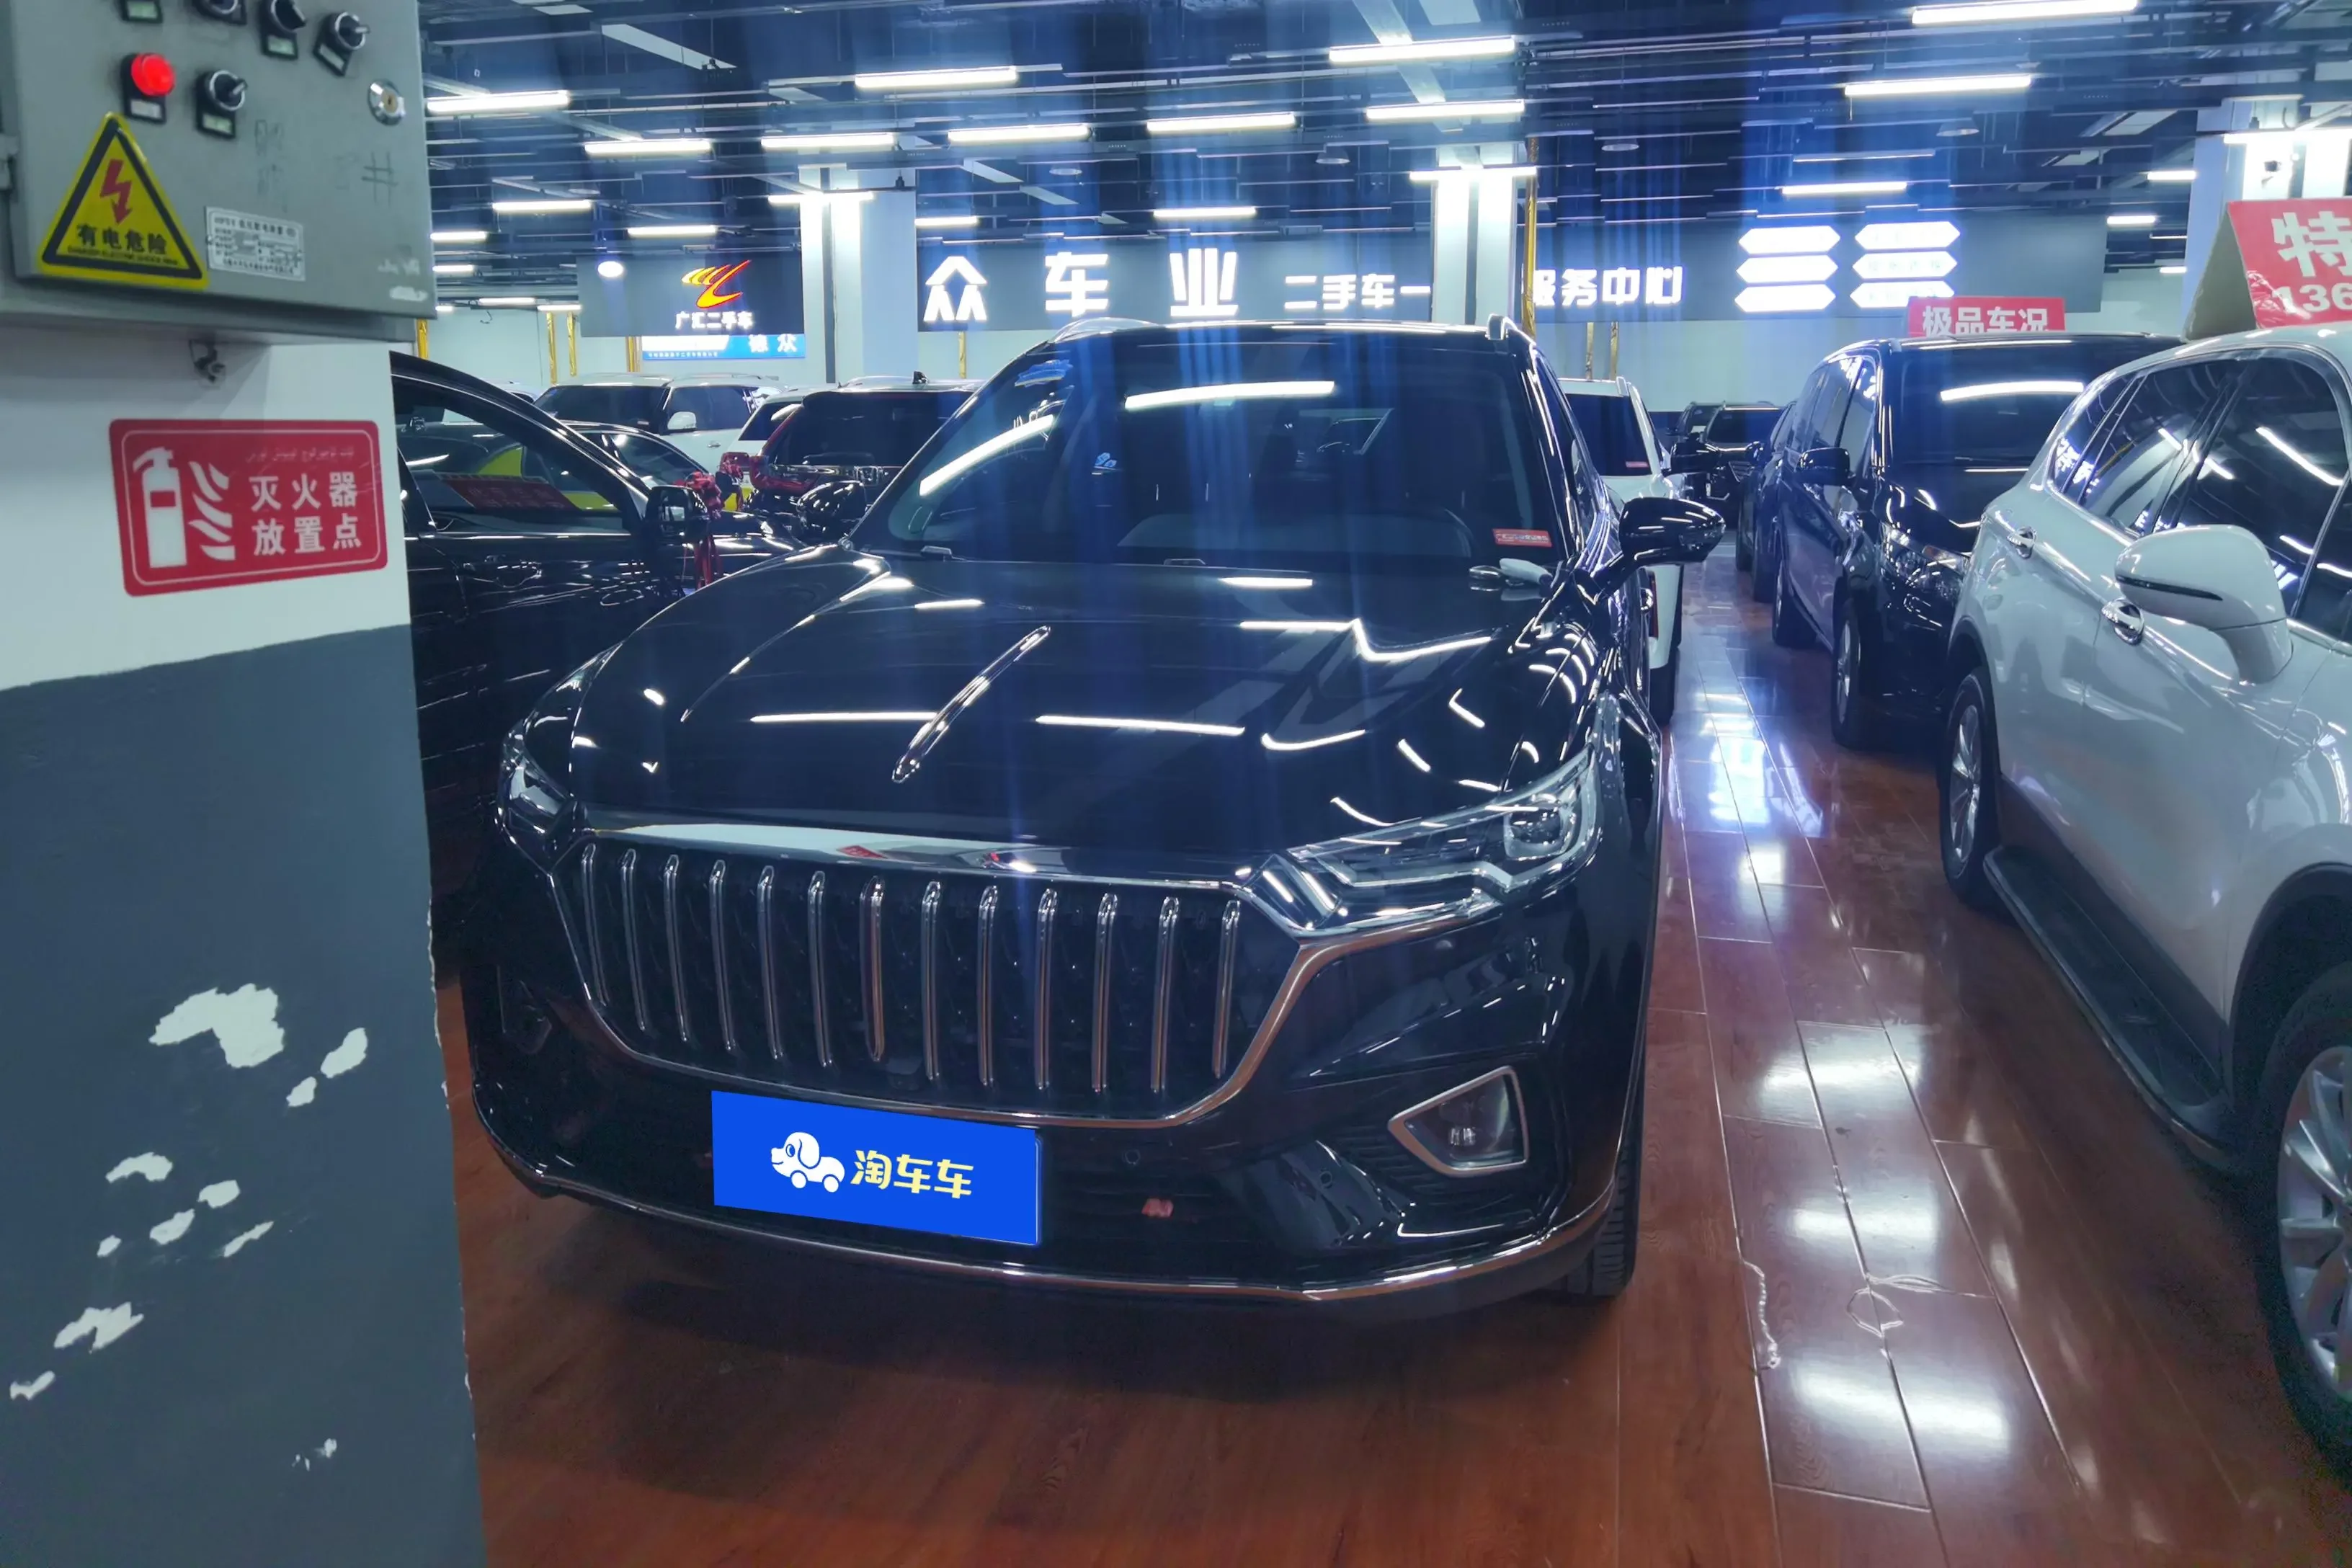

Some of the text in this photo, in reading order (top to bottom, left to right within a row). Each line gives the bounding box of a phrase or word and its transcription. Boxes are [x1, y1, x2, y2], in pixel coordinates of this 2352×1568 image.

[76, 224, 166, 254] 有电危险
[922, 249, 1238, 322] 众车业
[674, 311, 753, 329] 广汇二手车
[1923, 306, 2049, 337] 极品车况
[249, 471, 357, 511] 灭火器
[251, 512, 362, 556] 放置点
